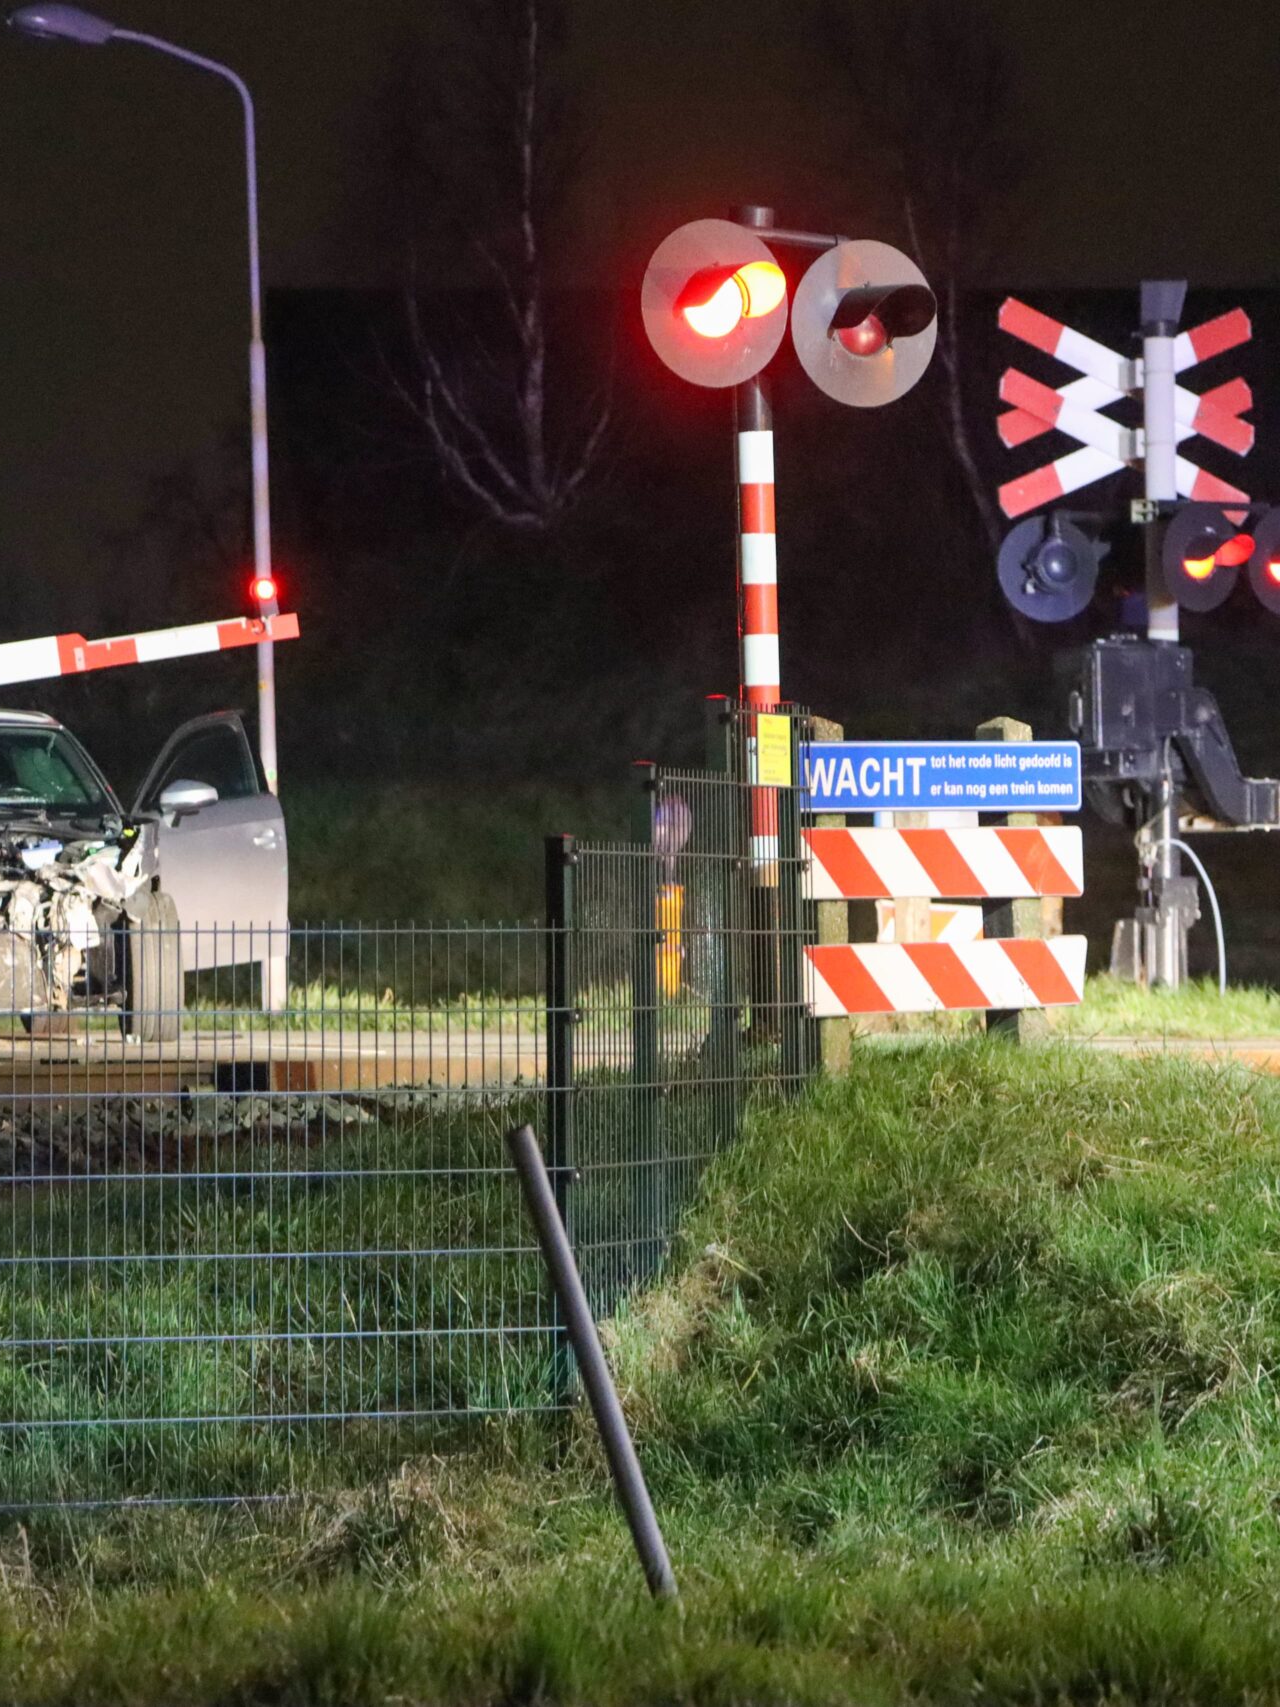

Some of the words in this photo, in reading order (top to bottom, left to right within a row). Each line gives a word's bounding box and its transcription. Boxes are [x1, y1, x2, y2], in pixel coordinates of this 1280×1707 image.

[931, 755, 946, 768] tot
[949, 754, 966, 768] het
[969, 754, 992, 768] rode
[995, 754, 1016, 768] licht
[1019, 754, 1061, 771] gedoofd
[1063, 754, 1072, 768] is
[804, 757, 926, 797] WACHT
[931, 784, 941, 796] er
[944, 781, 963, 795] kan
[966, 784, 986, 798] nog
[989, 784, 1008, 795] een
[1011, 781, 1035, 795] trein
[1037, 781, 1073, 795] komen
